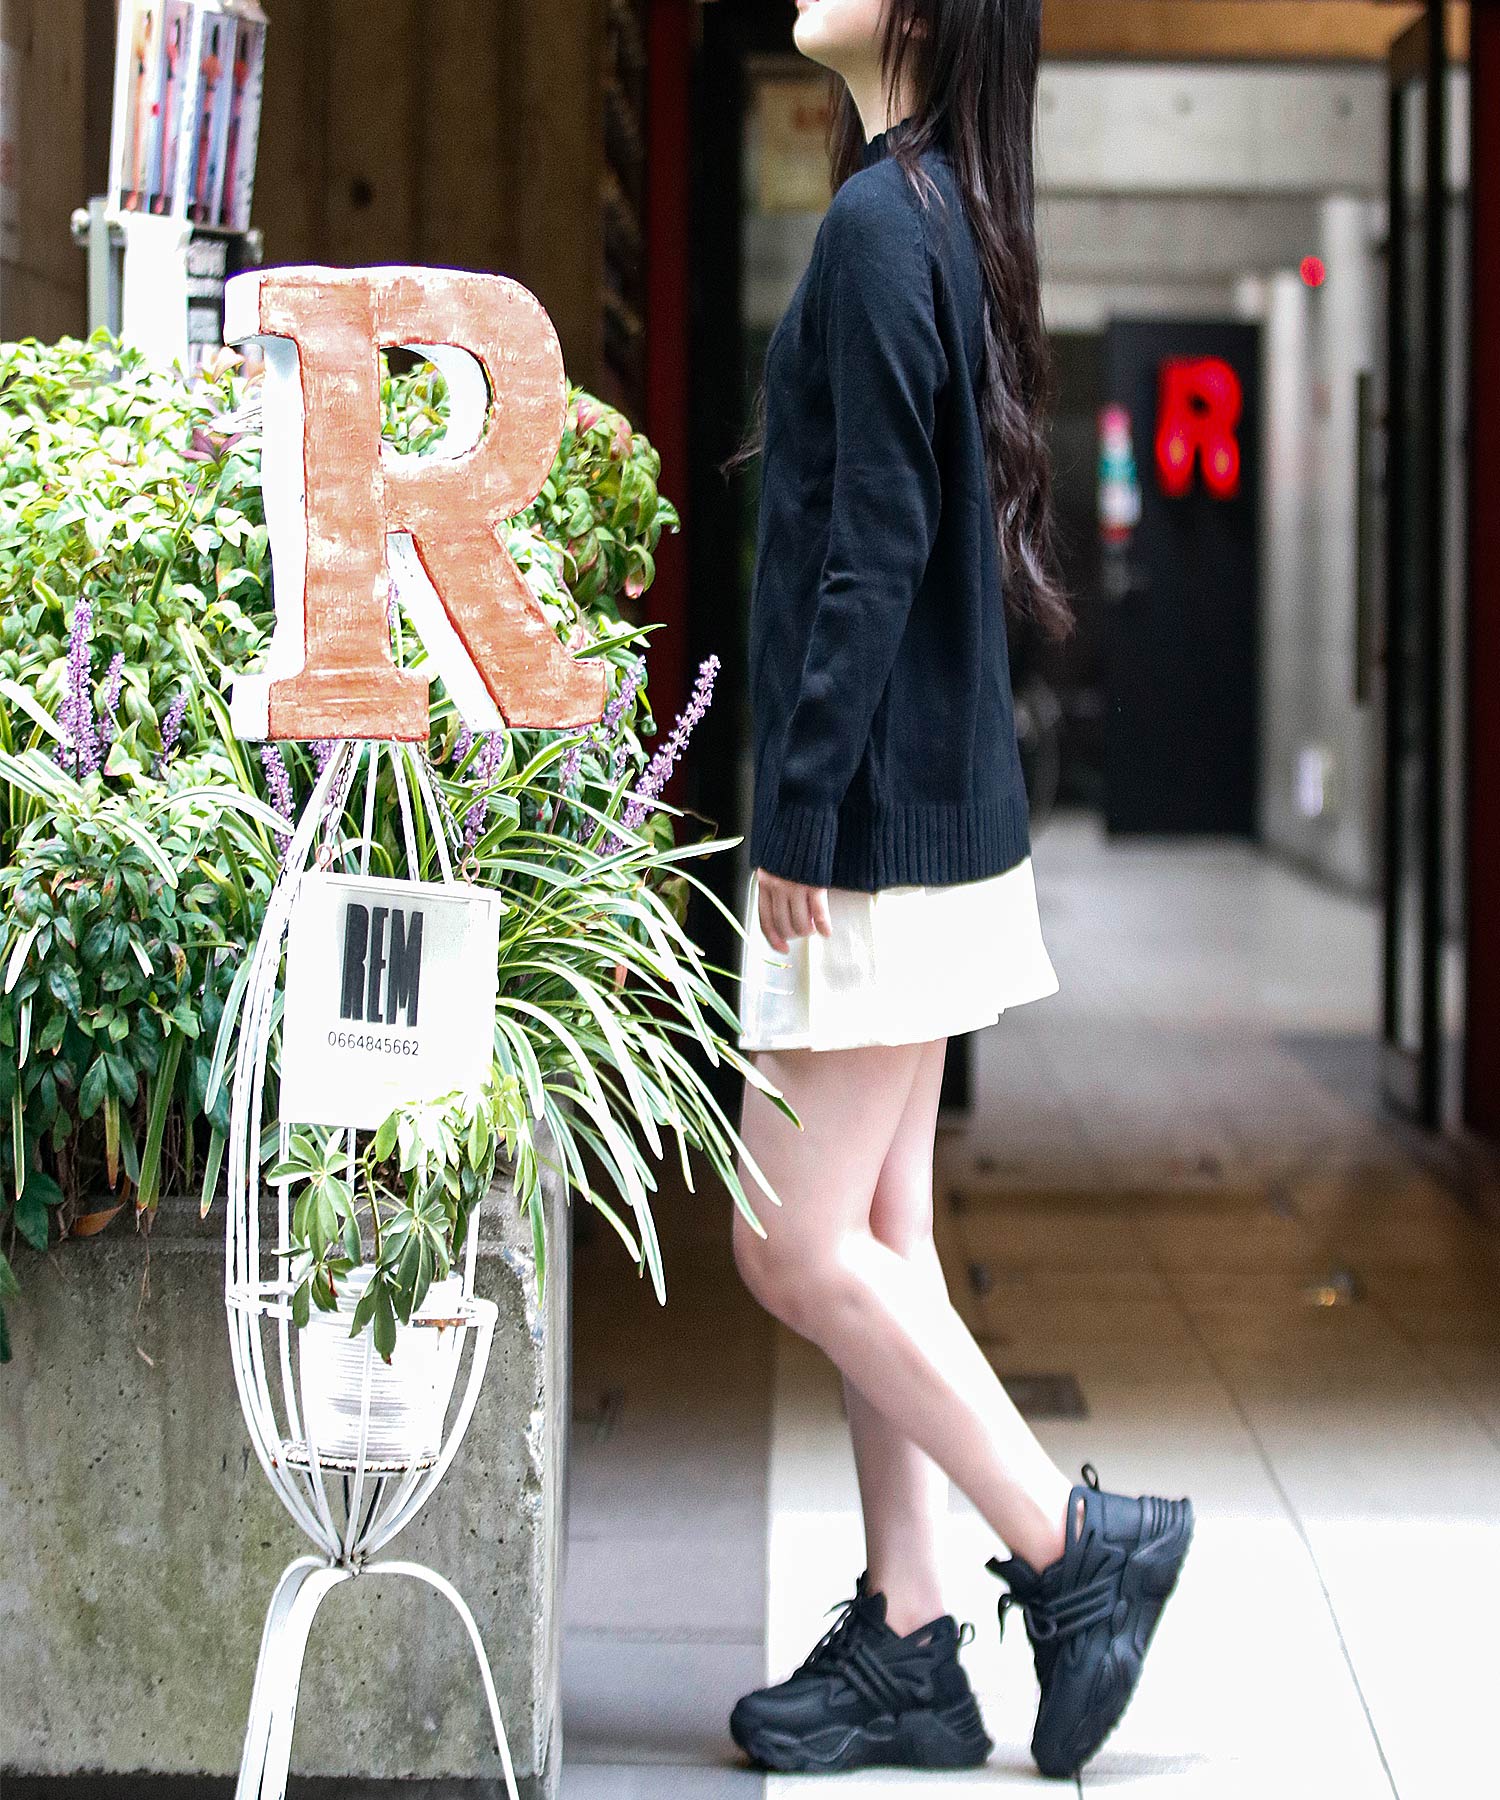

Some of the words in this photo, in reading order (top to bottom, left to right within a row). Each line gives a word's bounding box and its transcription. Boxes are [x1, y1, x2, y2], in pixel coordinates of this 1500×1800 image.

[1156, 355, 1242, 498] R
[226, 266, 605, 742] R
[340, 903, 423, 1027] REM
[328, 1031, 419, 1056] 0664845662
